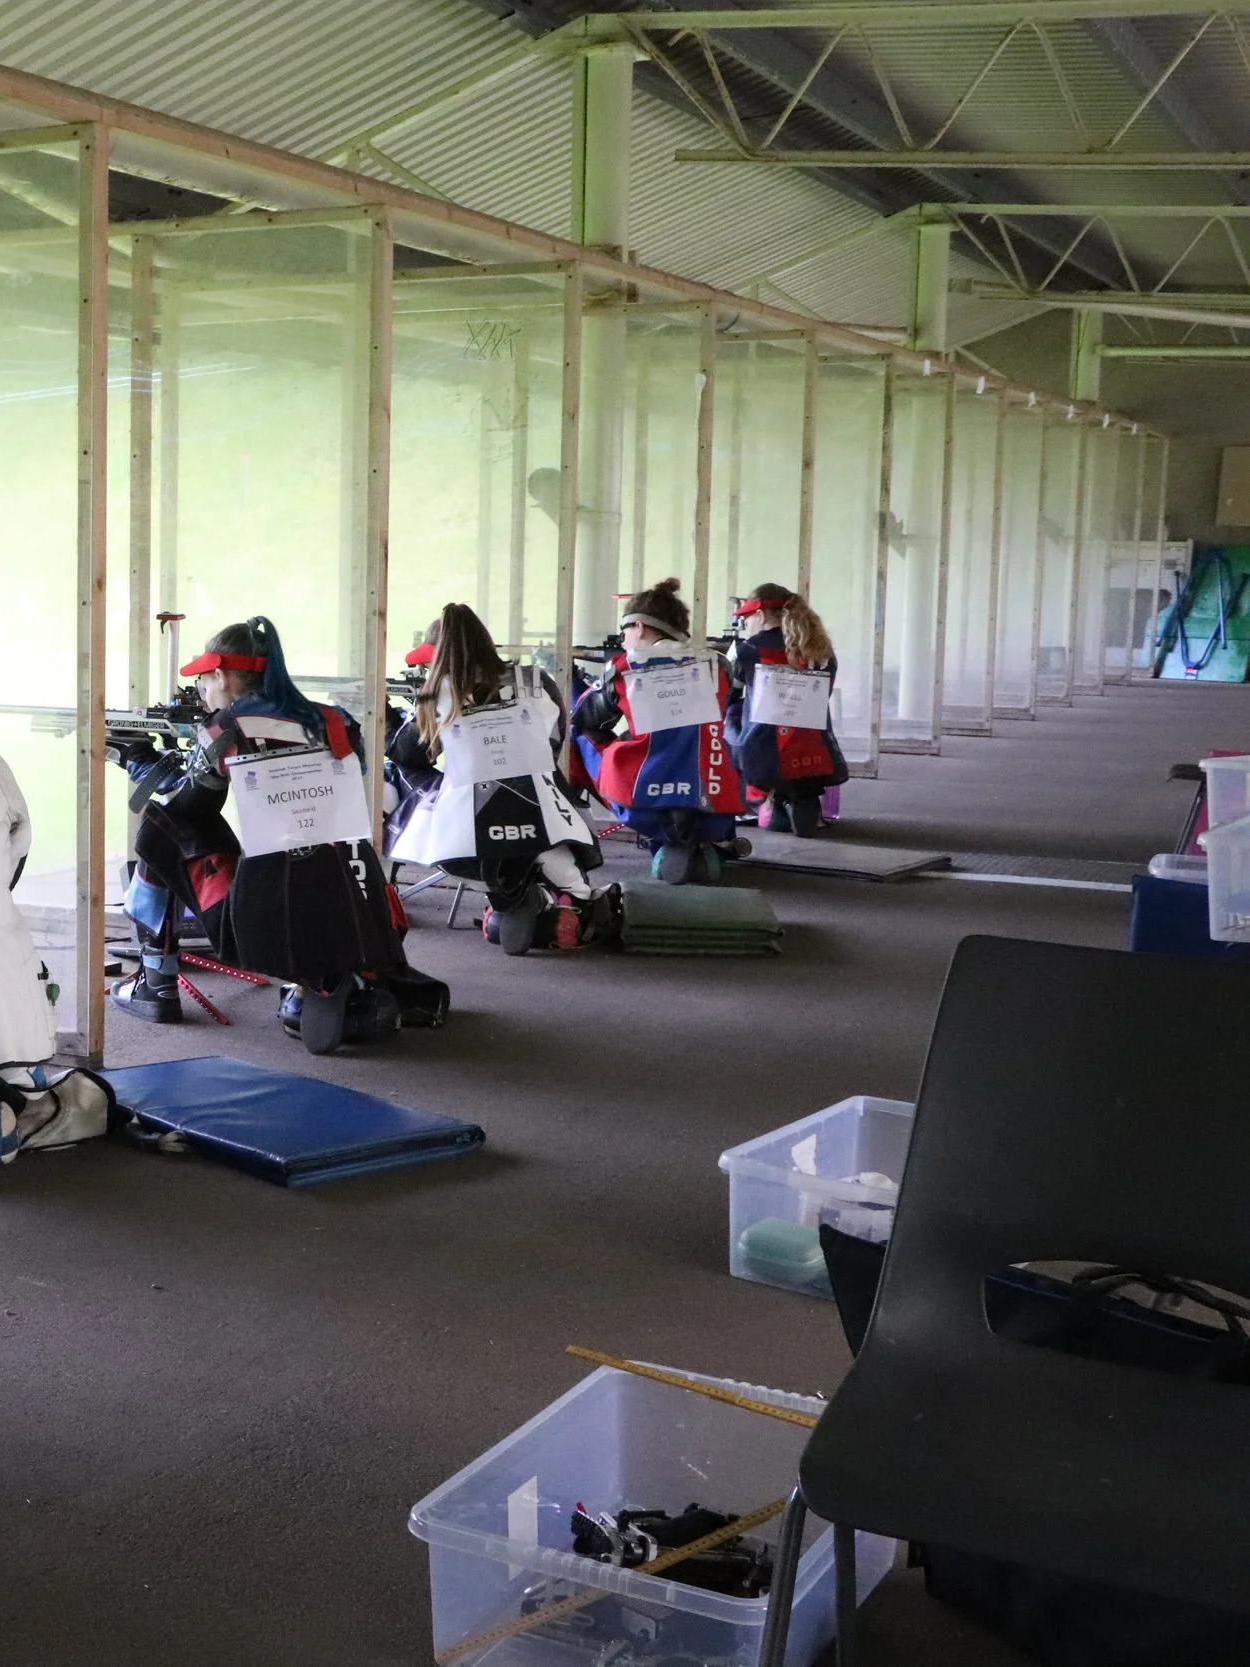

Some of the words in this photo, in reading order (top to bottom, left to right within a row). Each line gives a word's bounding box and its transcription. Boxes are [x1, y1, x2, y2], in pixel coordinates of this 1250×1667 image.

[657, 688, 686, 699] GOULD
[483, 734, 507, 746] BALE
[709, 724, 723, 795] GOULD
[267, 785, 334, 805] MCINTOSH
[647, 782, 691, 796] GBR
[298, 818, 315, 829] 122
[488, 824, 537, 840] GBR
